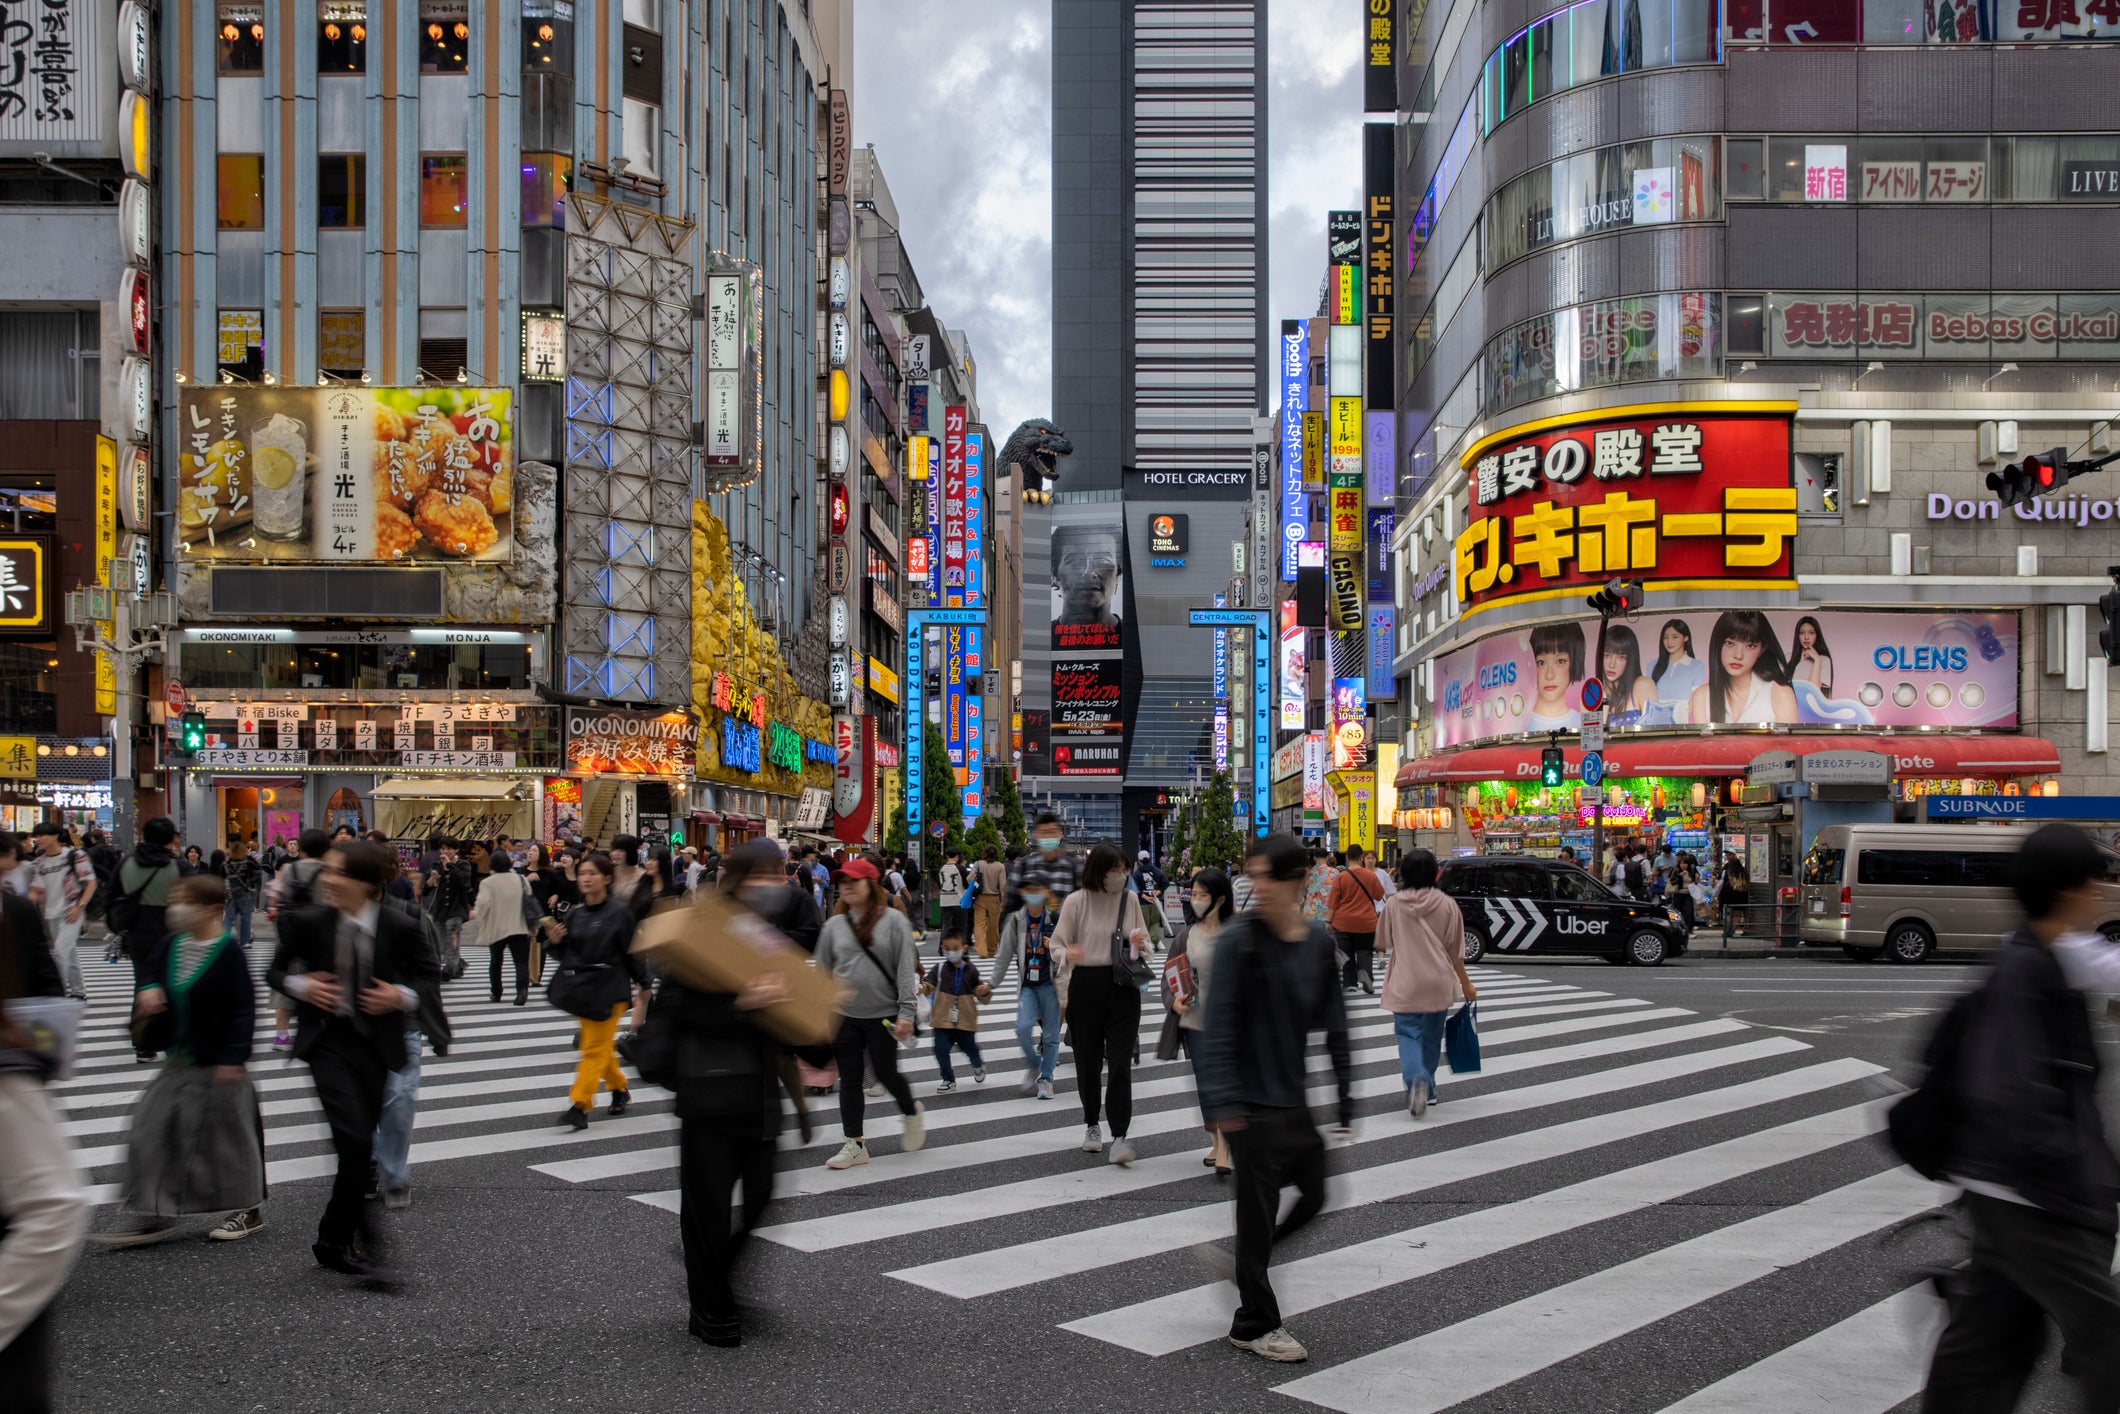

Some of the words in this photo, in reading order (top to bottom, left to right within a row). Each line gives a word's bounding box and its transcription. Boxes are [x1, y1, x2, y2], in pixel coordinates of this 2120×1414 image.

[1807, 166, 1845, 200] 新宿
[1866, 167, 1919, 198] アイドル
[1928, 166, 1983, 198] ステージ
[1577, 197, 1633, 230] HOUSE
[219, 314, 260, 328] チキン
[1579, 307, 1659, 333] Free
[1783, 301, 1915, 345] 免税店
[1931, 312, 2022, 340] Bebas
[2029, 311, 2119, 340] Cukai
[219, 345, 247, 363] 4F
[322, 334, 362, 350] レモン
[321, 352, 362, 368] サワー
[536, 354, 556, 376] 光
[913, 342, 924, 371] ダーツ
[1306, 416, 1316, 449] 生ビール
[1339, 401, 1350, 442] 生ビール
[414, 404, 439, 476] チキンが
[717, 429, 730, 443] 光
[1286, 382, 1303, 517] きれいなネットカフェ
[1333, 446, 1361, 455] 199円
[188, 404, 221, 548] レモンサワー
[1477, 423, 1703, 506] 驚安の殿堂
[334, 473, 356, 499] 光
[945, 413, 964, 560] カラオケ歌広場
[1144, 473, 1186, 484] HOTEL
[1187, 472, 1247, 484] GRACERY
[1337, 476, 1356, 486] 4F
[1335, 491, 1358, 533] 麻雀
[1928, 493, 1999, 520] Don
[333, 535, 357, 554] 4F
[1151, 558, 1186, 567] IMAX
[1332, 557, 1362, 625] CASINO
[928, 612, 977, 622] KABUKI町
[200, 633, 276, 642] OKONOMIYAKI
[445, 634, 491, 642] MONJA
[1216, 629, 1226, 693] カラオケランド
[1872, 644, 1970, 673] OLENS
[1480, 661, 1517, 690] OLENS
[908, 642, 920, 744] GODZILLA
[267, 707, 300, 718] Biske
[442, 706, 510, 720] うさぎや
[570, 718, 699, 742] OKONOMIYAKI
[1257, 658, 1268, 795] ゴジラロード
[6, 743, 33, 772] 集
[577, 738, 688, 764] お好み焼き
[1074, 748, 1119, 760] MARUHAN
[1807, 759, 1884, 769] 安全安心ステーション
[908, 756, 920, 804] ROAD
[1344, 775, 1373, 783] カラオケ
[1584, 760, 1594, 781] P
[1939, 799, 2026, 815] SUBNADE
[1556, 915, 1610, 935] Uber
